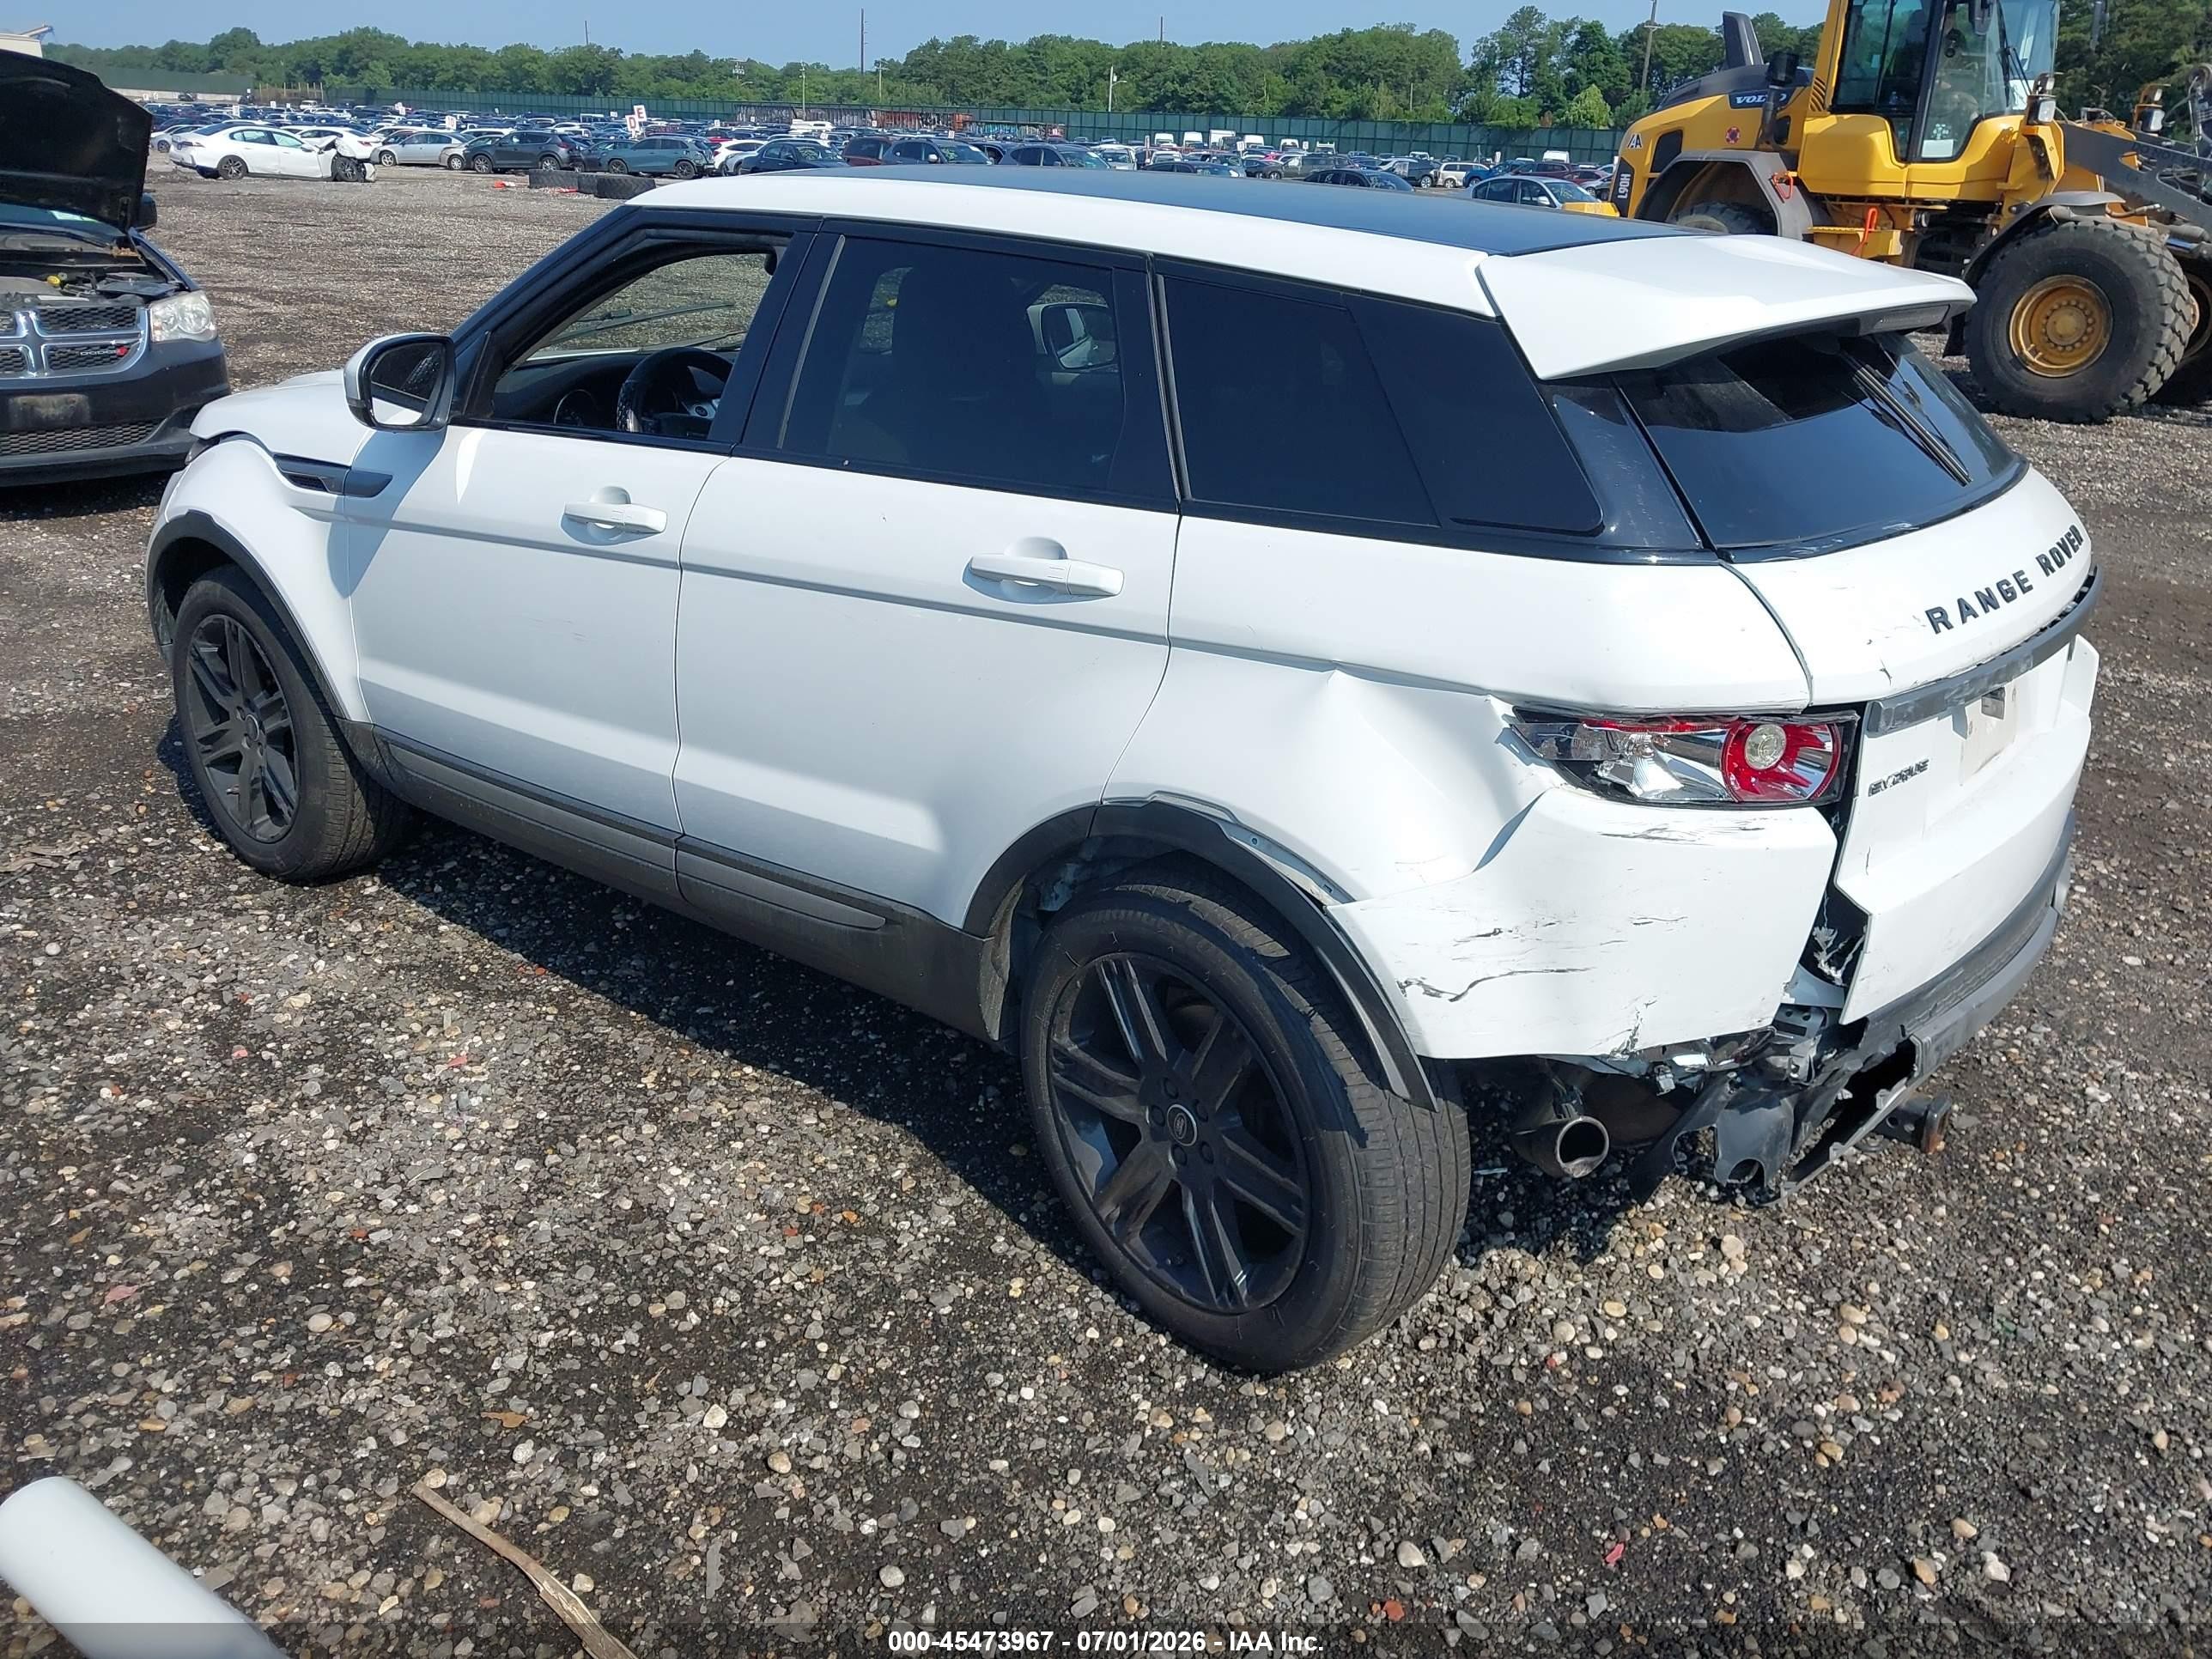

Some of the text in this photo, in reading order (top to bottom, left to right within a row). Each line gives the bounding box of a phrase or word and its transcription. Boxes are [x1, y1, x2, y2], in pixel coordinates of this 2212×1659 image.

[1735, 93, 1787, 104] VOLO
[636, 107, 645, 118] E
[629, 117, 636, 129] D
[1617, 173, 1632, 199] L90H
[1925, 524, 2084, 635] RANGE ROVER
